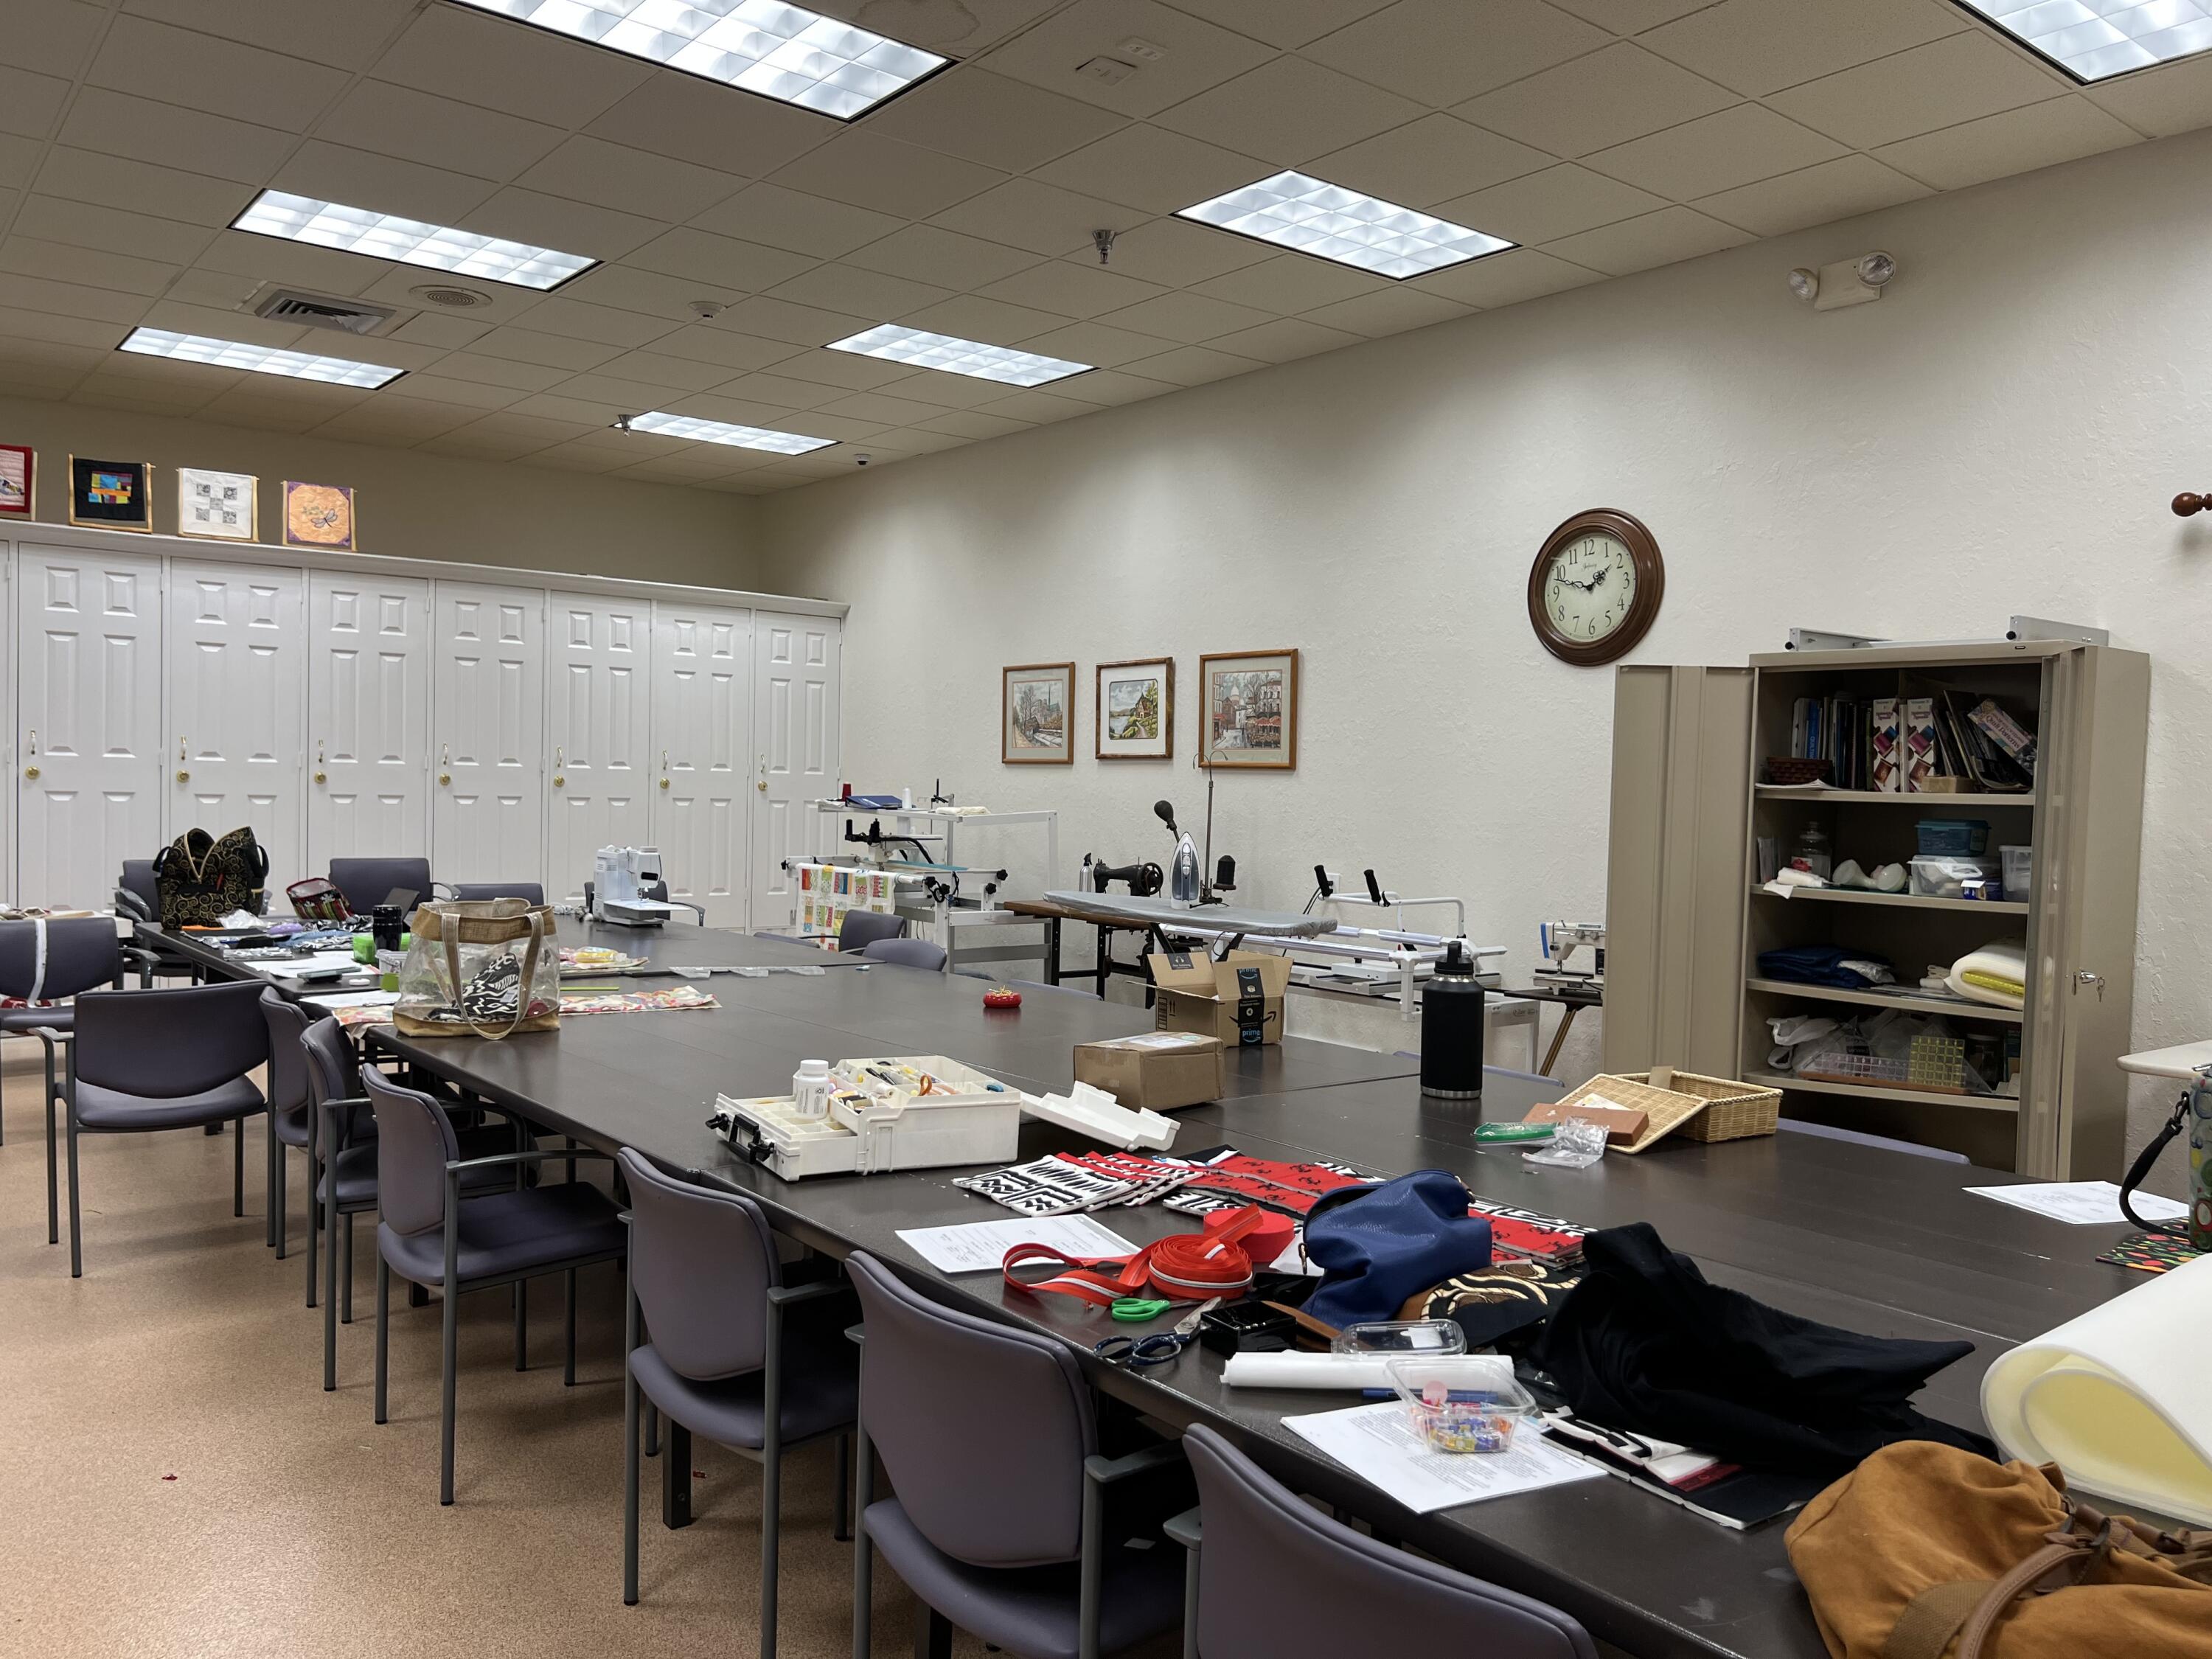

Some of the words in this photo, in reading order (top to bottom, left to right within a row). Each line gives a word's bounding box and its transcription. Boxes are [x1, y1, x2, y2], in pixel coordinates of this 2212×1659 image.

[1583, 539, 1596, 557] 12
[1604, 542, 1609, 558] 1
[1568, 549, 1579, 565] 11
[1616, 553, 1624, 569] 2
[1556, 565, 1566, 580] 10
[1623, 572, 1630, 589] 3
[1553, 585, 1559, 602] 9
[1617, 594, 1625, 611] 4
[1558, 605, 1565, 622] 8
[1604, 611, 1612, 627] 5
[1573, 616, 1579, 633] 7
[1588, 617, 1596, 635] 6
[1242, 1029, 1261, 1037] prime
